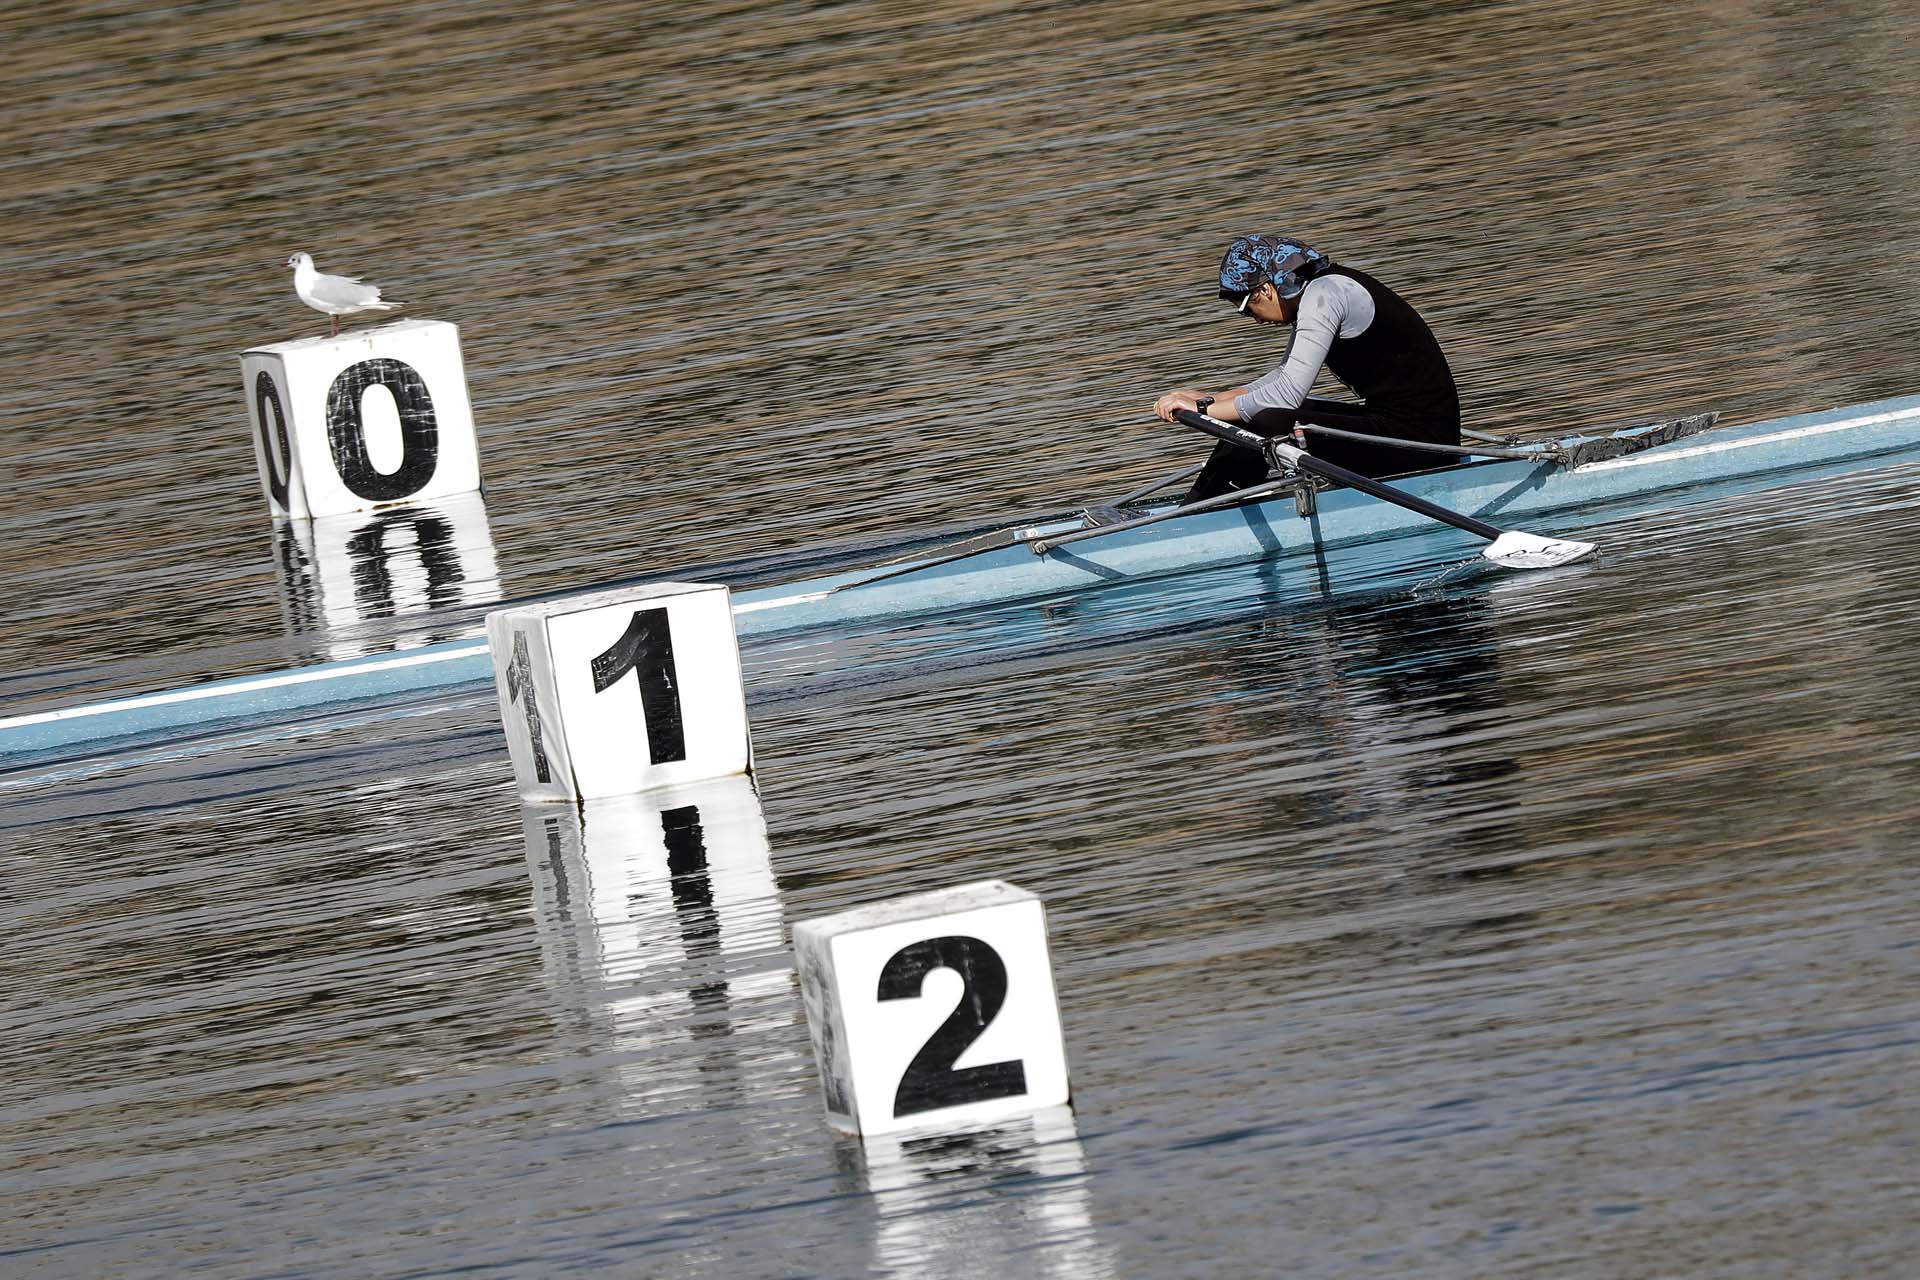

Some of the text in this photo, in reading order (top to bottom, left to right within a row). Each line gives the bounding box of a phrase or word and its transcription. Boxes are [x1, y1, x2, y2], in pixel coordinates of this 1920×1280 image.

[256, 370, 292, 513] 0
[326, 358, 439, 502] 0
[506, 630, 552, 784] 1
[590, 606, 687, 766] 1
[877, 935, 1029, 1120] 2
